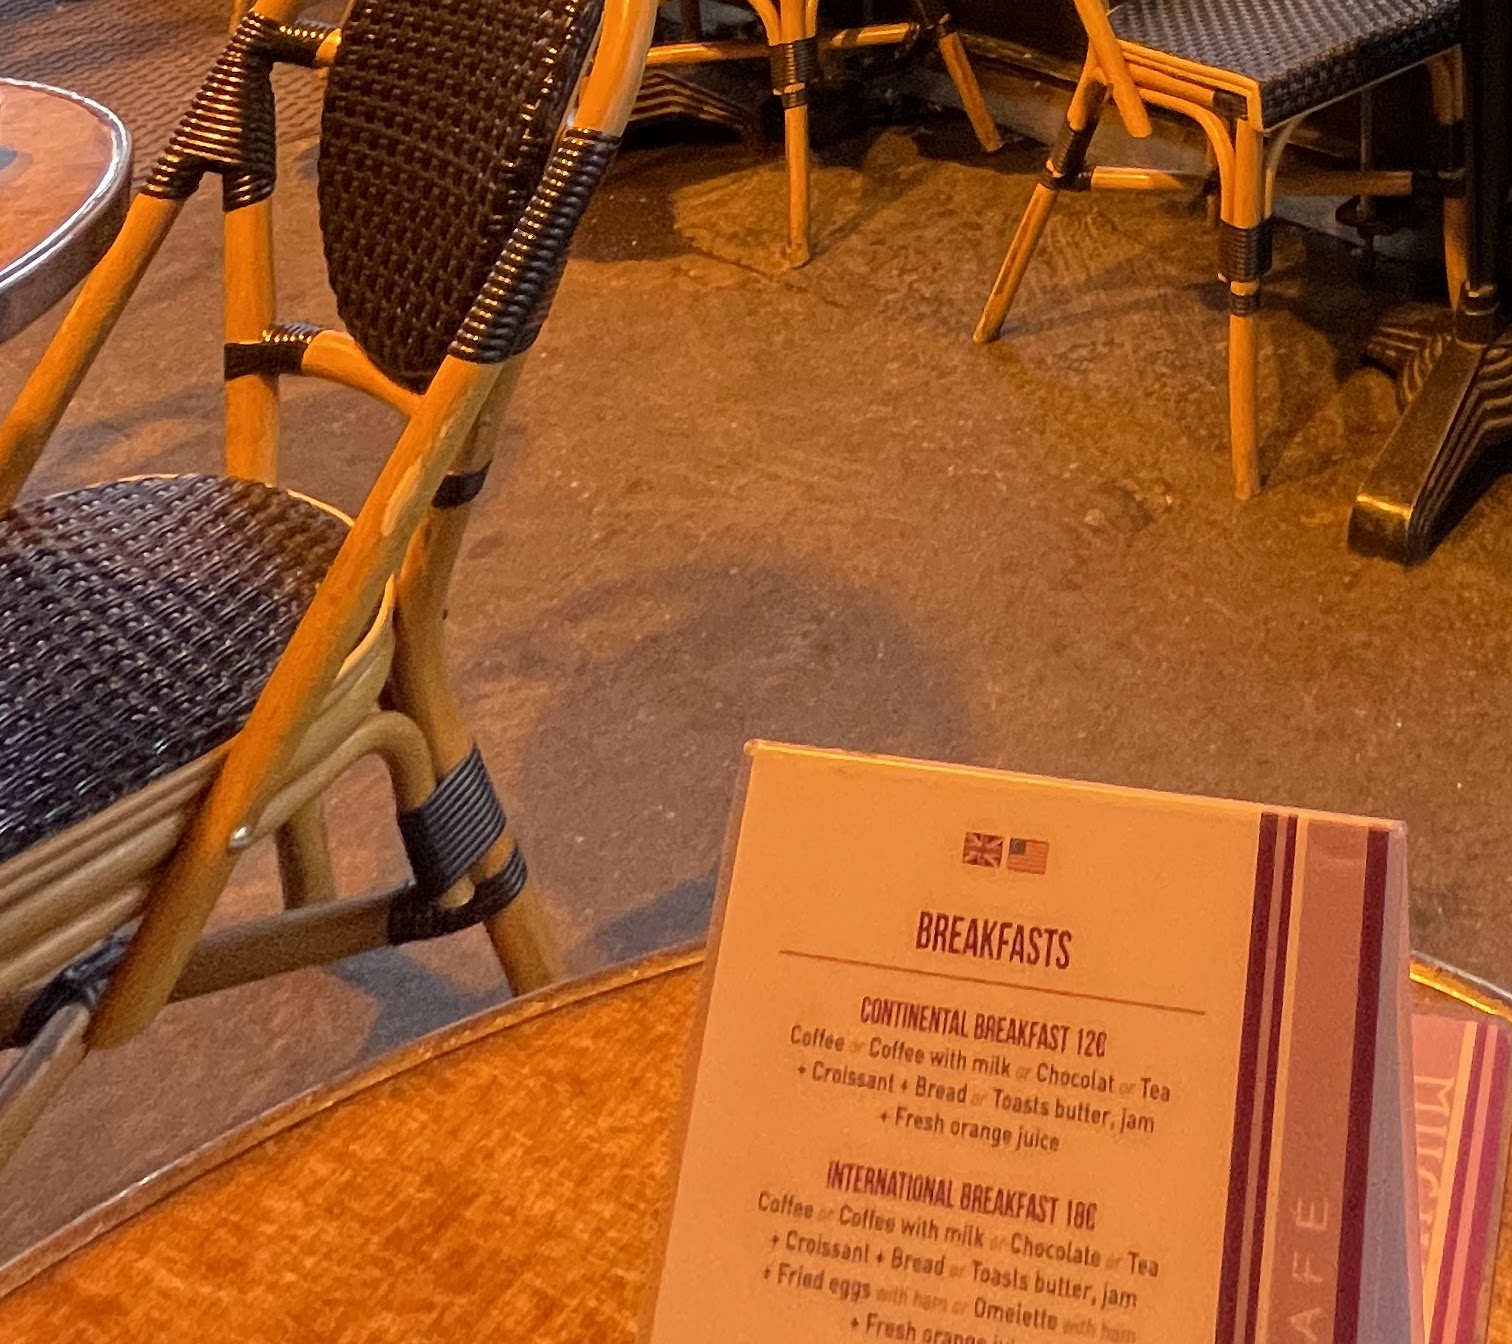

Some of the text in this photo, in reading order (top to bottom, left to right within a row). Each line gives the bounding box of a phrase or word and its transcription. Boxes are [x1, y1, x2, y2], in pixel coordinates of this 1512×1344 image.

[915, 911, 1072, 970] BREAKFASTS
[860, 996, 968, 1039] CONTINENTAL
[973, 1012, 1071, 1055] BREAKFAST
[791, 1024, 844, 1053] Coffee
[869, 1036, 924, 1065] Coffee
[930, 1044, 966, 1072] with
[972, 1053, 1011, 1079] milk
[1036, 1062, 1114, 1094] Chocolat
[1140, 1077, 1171, 1103] Tea
[812, 1060, 894, 1094] Croissant
[915, 1075, 967, 1104] Bread
[993, 1087, 1049, 1118] Toasts
[1055, 1102, 1115, 1131] butter,
[1119, 1110, 1155, 1135] jam
[895, 1105, 944, 1133] Fresh
[950, 1119, 1012, 1148] orange
[1015, 1130, 1060, 1152] juice
[826, 1160, 954, 1209] INTERNATIONAL
[960, 1182, 1059, 1225] BREAKFAST
[757, 1190, 814, 1219] Coffee
[838, 1204, 895, 1234] Coffee
[901, 1215, 939, 1242] with
[944, 1223, 984, 1249] milk
[1011, 1231, 1101, 1269] Chocolate
[1128, 1251, 1160, 1278] Tea
[777, 1262, 824, 1291] Fried
[828, 1277, 872, 1304] eggs
[973, 1296, 1058, 1331] Omelette
[785, 1229, 870, 1265] Croissant
[891, 1246, 945, 1277] Bread
[971, 1259, 1029, 1291] Toasts
[1034, 1274, 1097, 1306] butter,
[1102, 1282, 1138, 1309] jam
[865, 1312, 917, 1342] Fresh
